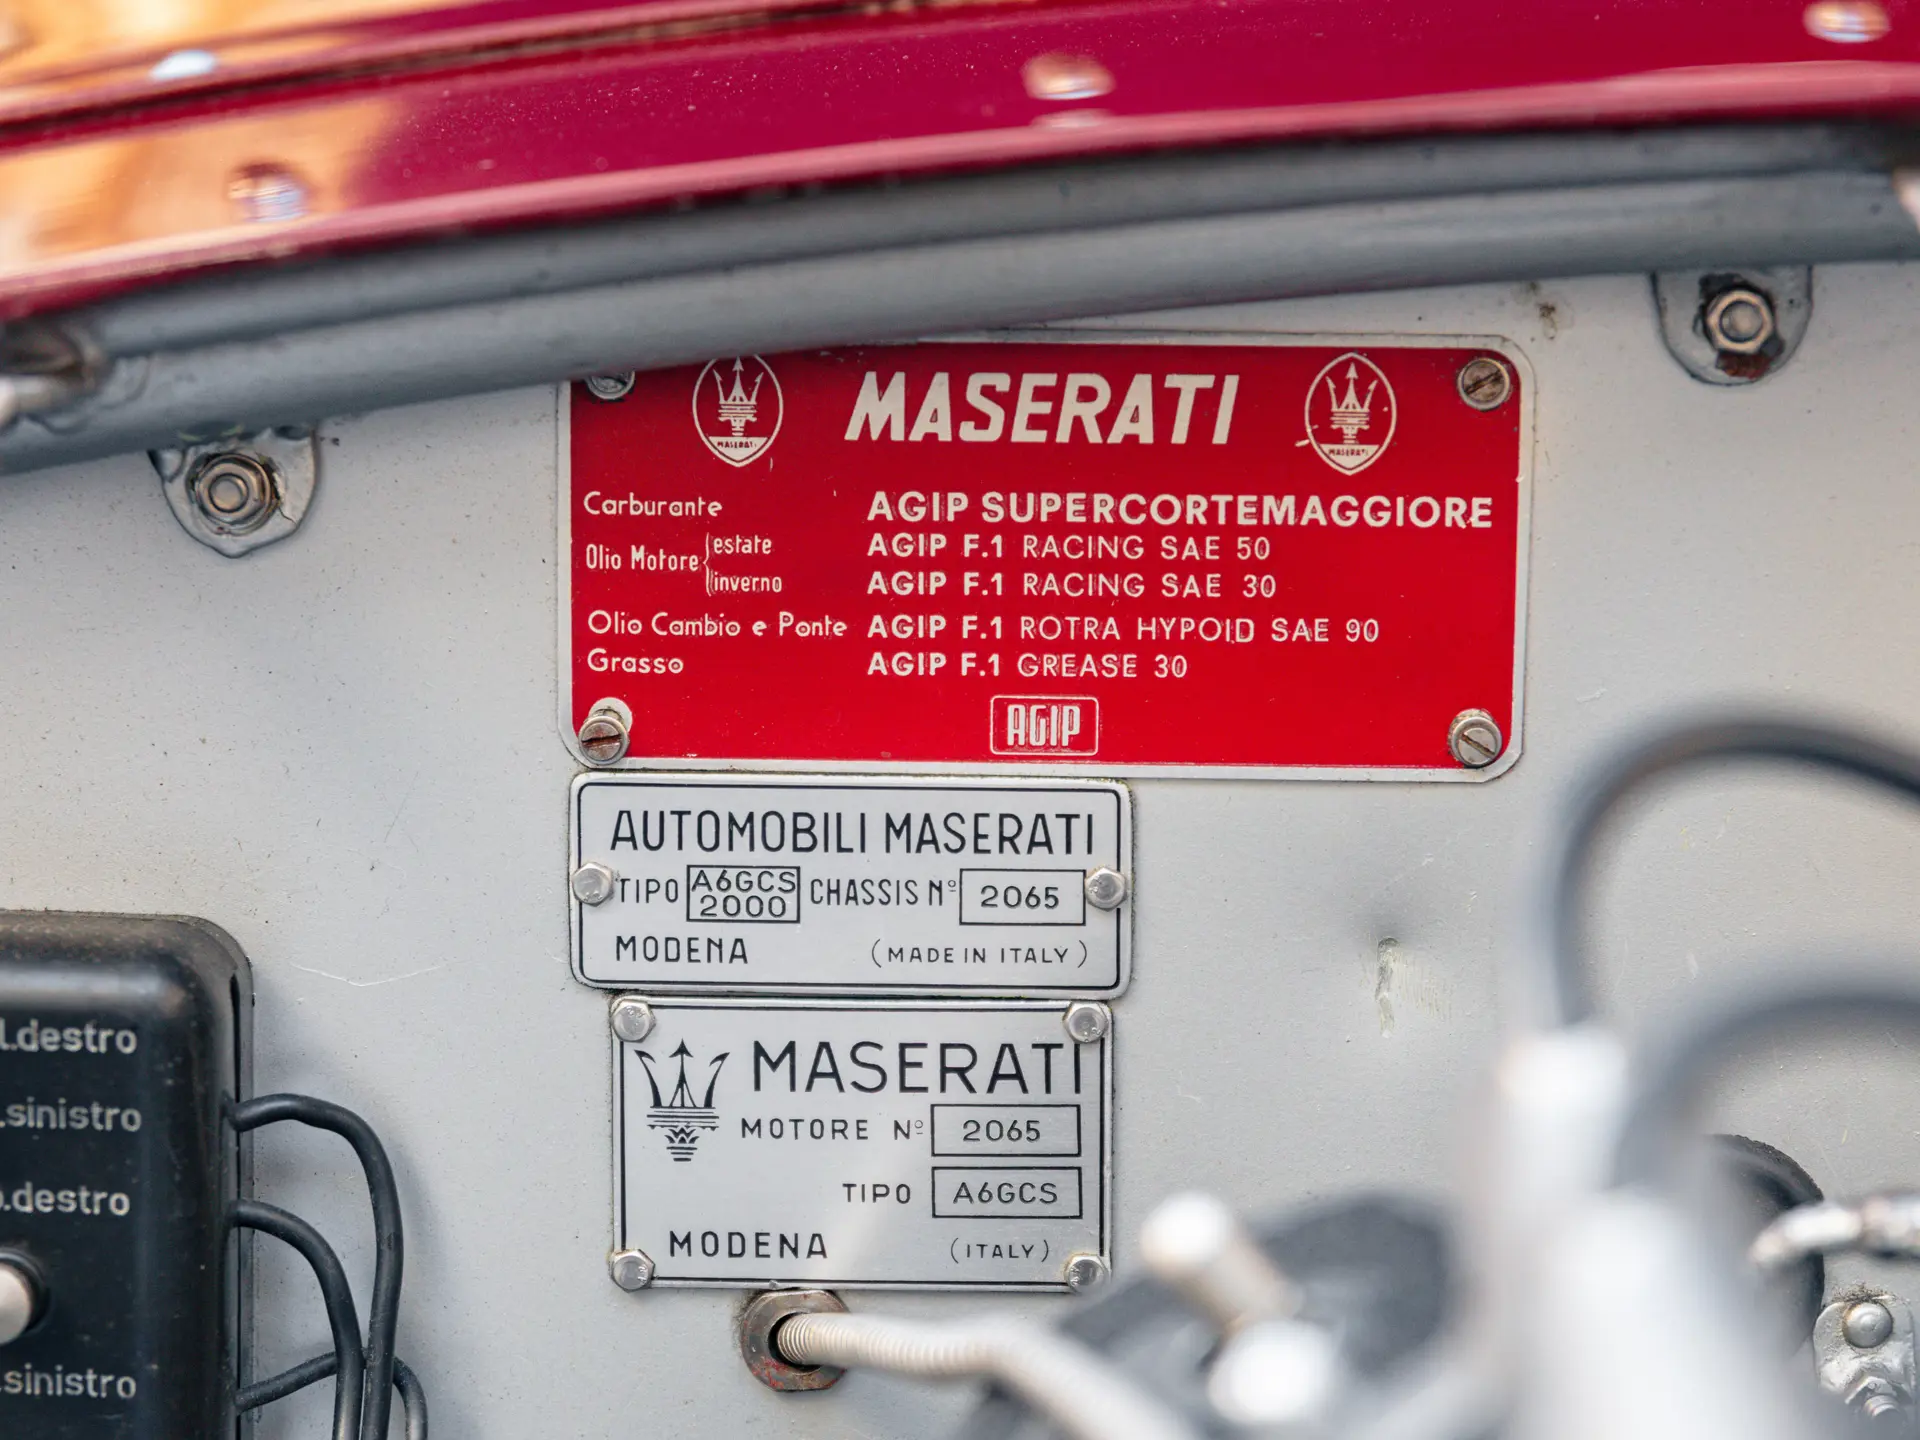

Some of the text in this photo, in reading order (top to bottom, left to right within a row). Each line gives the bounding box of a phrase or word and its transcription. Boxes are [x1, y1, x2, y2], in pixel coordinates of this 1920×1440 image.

[845, 372, 1239, 444] MASERATI
[584, 491, 722, 516] Carburante
[868, 491, 1492, 528] AGIP SUPERCORTEMAGGIORE
[587, 544, 698, 571] Olio Motore
[714, 535, 771, 554] estate
[868, 533, 1269, 560] AGIP F.1 RACING SAE 50
[715, 572, 782, 592] inverno
[867, 571, 1275, 597] AGIP F.1 RACING SAE 30
[588, 610, 847, 636] Olio Cambio e Ponte
[868, 615, 1378, 642] AGIP F.1 ROTRA HYPOID SAE 90
[588, 648, 683, 674] Grasso
[868, 652, 1187, 678] AGIP F.1 GREASE 30
[1008, 705, 1080, 746] AGIP
[611, 810, 1092, 854] AUTOMOBILI MASERATI
[620, 879, 678, 903] TIPO
[692, 870, 796, 892] A6GCS
[811, 879, 918, 905] CHASSIS
[701, 895, 786, 917] 2000
[981, 886, 1058, 909] 2065
[616, 936, 747, 963] MODENA
[872, 939, 1087, 968] (MADE IN ITALY)
[754, 1040, 1081, 1095] MASERATI
[742, 1118, 868, 1140] MOTORE
[963, 1120, 1040, 1142] 2065
[843, 1184, 910, 1204] TIPO
[954, 1182, 1057, 1204] A6GCS
[670, 1231, 826, 1258] MODENA
[951, 1238, 1049, 1263] (ITALY)
